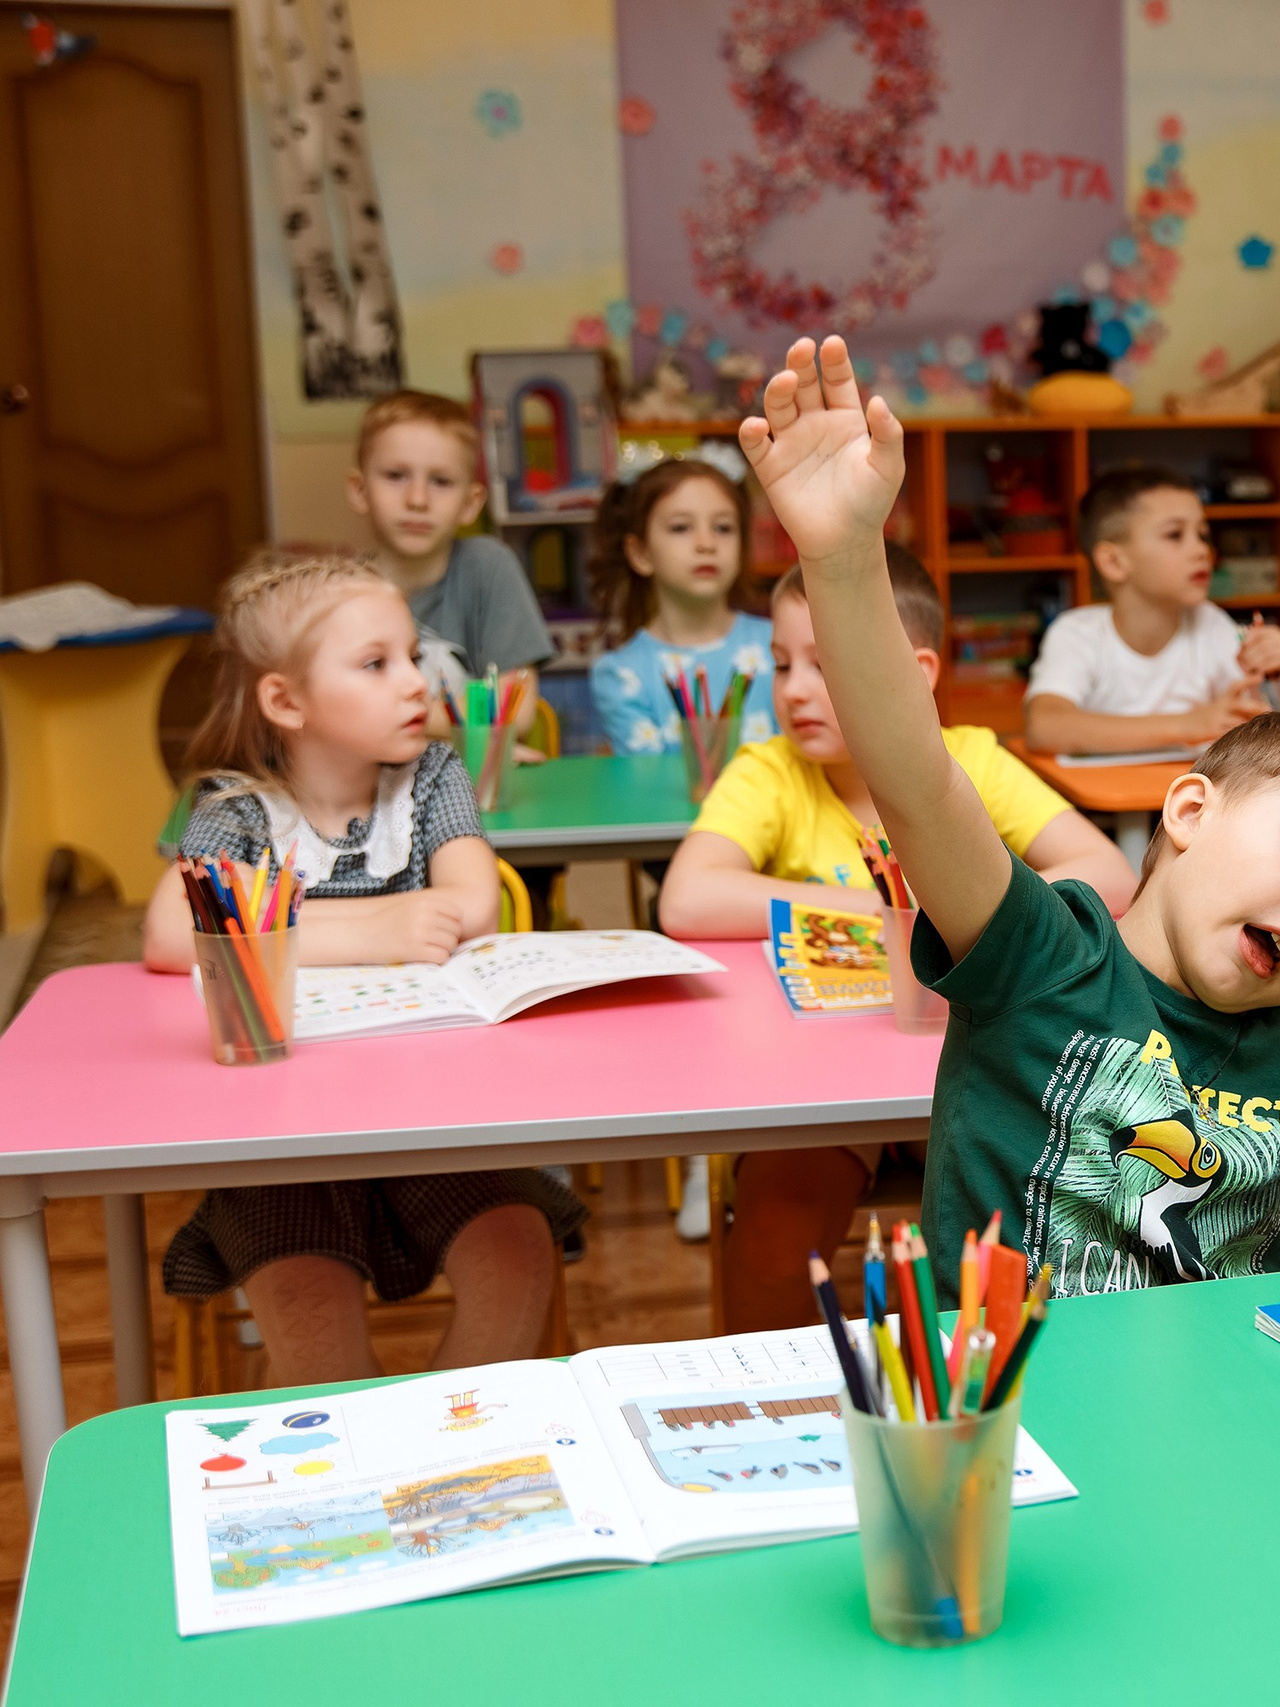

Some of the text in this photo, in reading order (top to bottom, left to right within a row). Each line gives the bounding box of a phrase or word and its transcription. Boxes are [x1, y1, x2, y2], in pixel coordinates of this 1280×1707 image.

[935, 144, 1115, 204] МАРТА
[1087, 1043, 1101, 1060] most
[1055, 1065, 1063, 1076] of
[1067, 1061, 1092, 1104] concentrated
[1041, 1073, 1059, 1112] populations
[1050, 1088, 1068, 1127] biodiversity
[1057, 1103, 1073, 1151] deforestation
[1043, 1171, 1053, 1179] in
[1047, 1152, 1062, 1172] occurs
[1025, 1178, 1036, 1206] changes
[1038, 1180, 1049, 1203] tropical
[1026, 1208, 1033, 1217] to
[1034, 1203, 1046, 1245] rainforests
[1022, 1217, 1033, 1246] climatic
[1080, 1240, 1150, 1296] CAN
